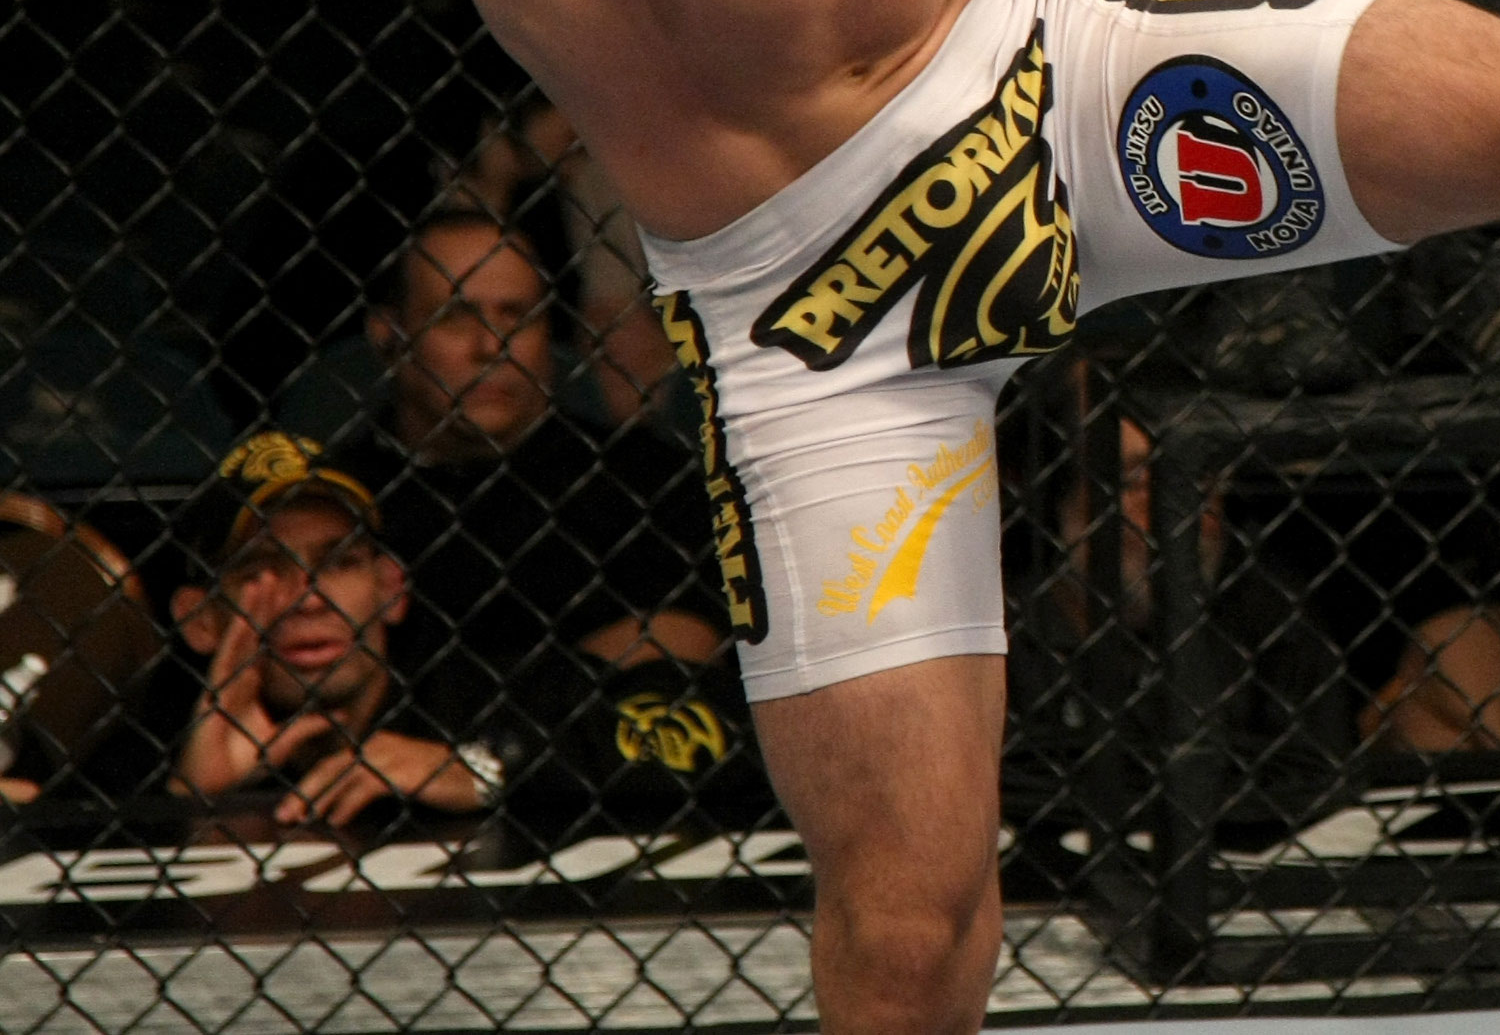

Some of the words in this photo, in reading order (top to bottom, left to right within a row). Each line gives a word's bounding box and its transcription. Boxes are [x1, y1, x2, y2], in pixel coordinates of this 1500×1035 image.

[1125, 95, 1168, 215] JIU-JITSU
[1246, 198, 1318, 252] NOVA
[817, 552, 878, 616] West
[851, 486, 915, 553] Coast
